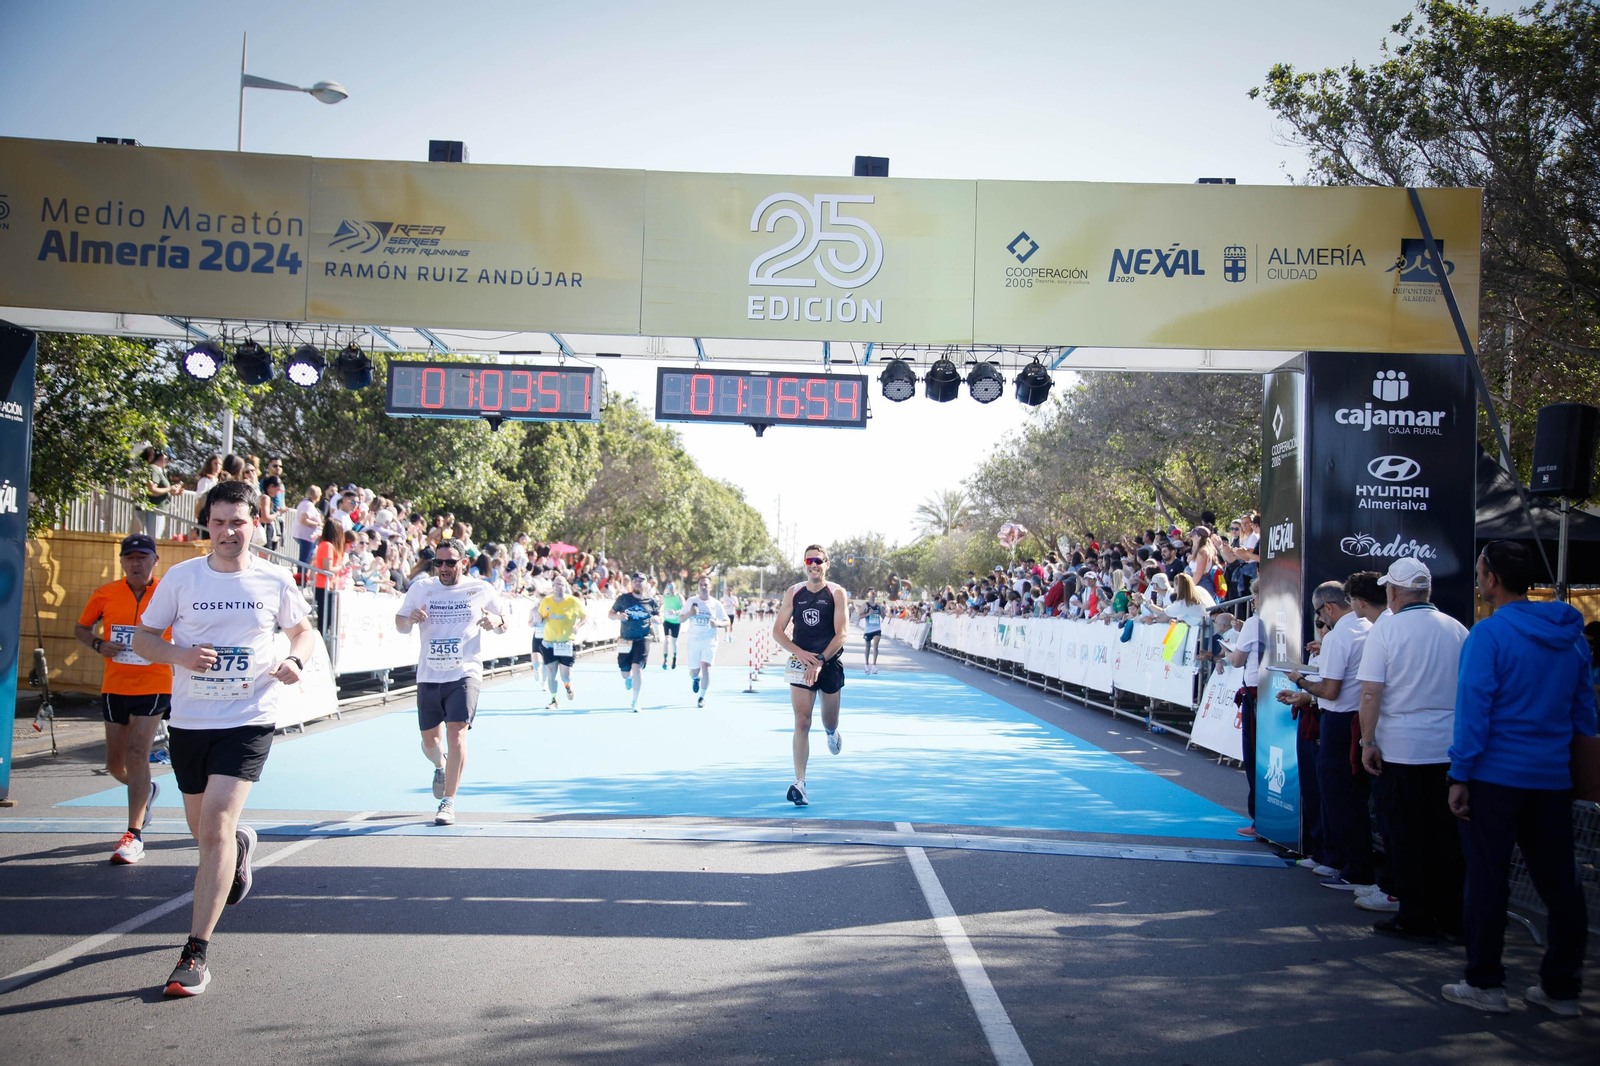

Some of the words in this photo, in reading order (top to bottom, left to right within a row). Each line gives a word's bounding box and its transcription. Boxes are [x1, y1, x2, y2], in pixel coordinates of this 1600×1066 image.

[41, 197, 145, 228] Medio
[163, 204, 303, 237] Maratón
[393, 223, 446, 237] RFEA
[388, 236, 440, 248] SERIES
[749, 191, 884, 289] 25
[37, 230, 190, 269] Almería
[199, 238, 303, 275] 2024
[383, 246, 416, 256] RUTA
[419, 248, 471, 257] RUNNING
[1267, 244, 1366, 266] ALMERÍA
[1108, 243, 1206, 283] NEXÁL
[324, 261, 407, 281] RAMÓN
[417, 266, 468, 283] RUIZ
[477, 267, 583, 288] ANDÚJAR
[1005, 267, 1088, 280] COOPERACIÓN
[1267, 268, 1318, 281] CIUDAD
[1005, 278, 1033, 289] 2005
[748, 292, 882, 324] EDICIÓN
[690, 374, 858, 420] 01:16:54
[1334, 403, 1446, 432] cajamar
[1388, 427, 1411, 435] CAJA
[1413, 427, 1443, 436] RURAL
[1356, 485, 1430, 499] HYUNDAI
[1358, 498, 1427, 511] Almerialva
[1267, 517, 1295, 559] NEXÁL
[192, 601, 264, 611] COSENTINO
[430, 644, 459, 654] 5456
[210, 655, 249, 672] 875
